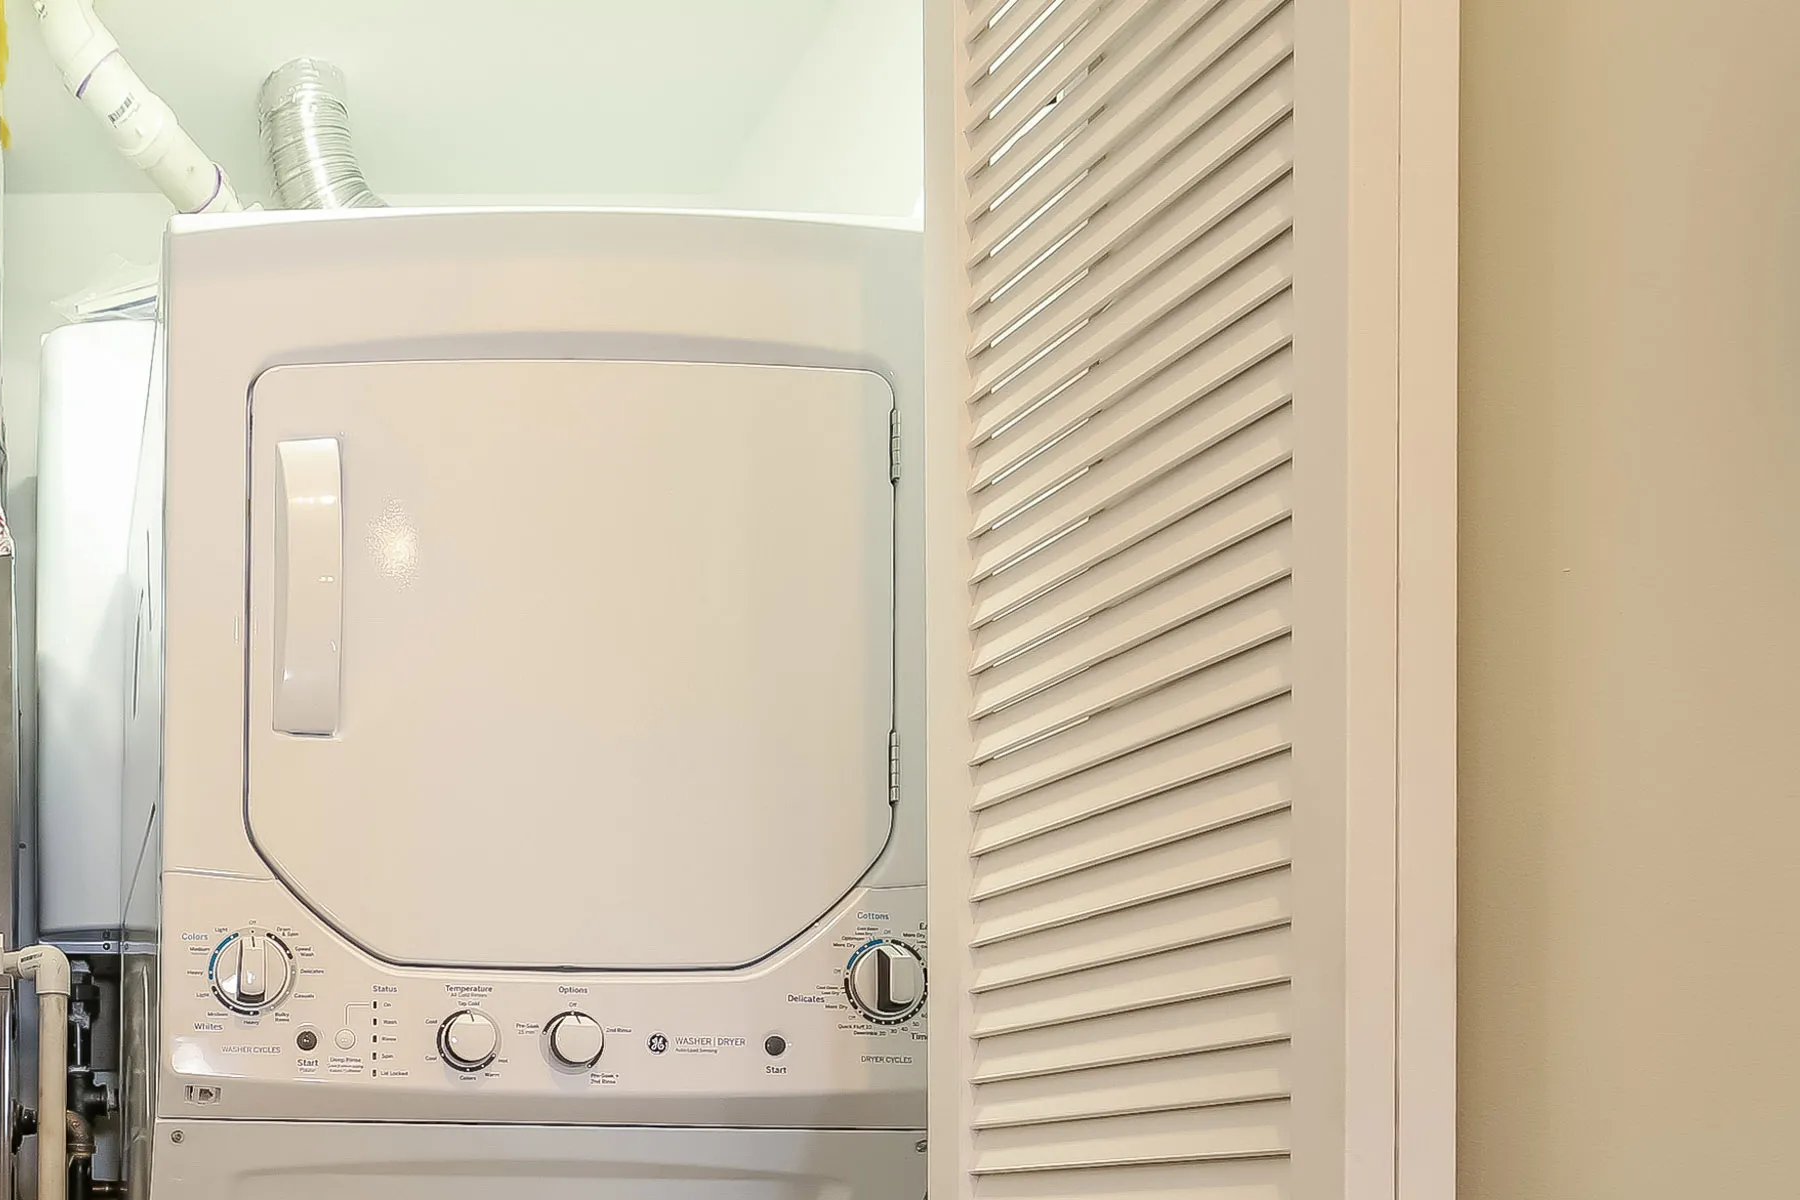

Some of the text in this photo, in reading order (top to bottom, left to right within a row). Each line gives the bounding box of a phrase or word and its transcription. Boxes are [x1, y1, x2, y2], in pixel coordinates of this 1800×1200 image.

[857, 912, 890, 920] Cottons
[181, 932, 209, 941] Colors
[372, 985, 398, 993] Status
[445, 985, 493, 995] Temperature
[558, 986, 588, 996] Options
[787, 994, 825, 1003] Delicates
[194, 1022, 224, 1031] Whites
[675, 1036, 746, 1047] WASHER DRYER
[222, 1046, 281, 1054] WASHER CYCLES
[297, 1058, 319, 1067] Start
[860, 1055, 913, 1065] DRYER CYCLES
[765, 1065, 787, 1075] Start
